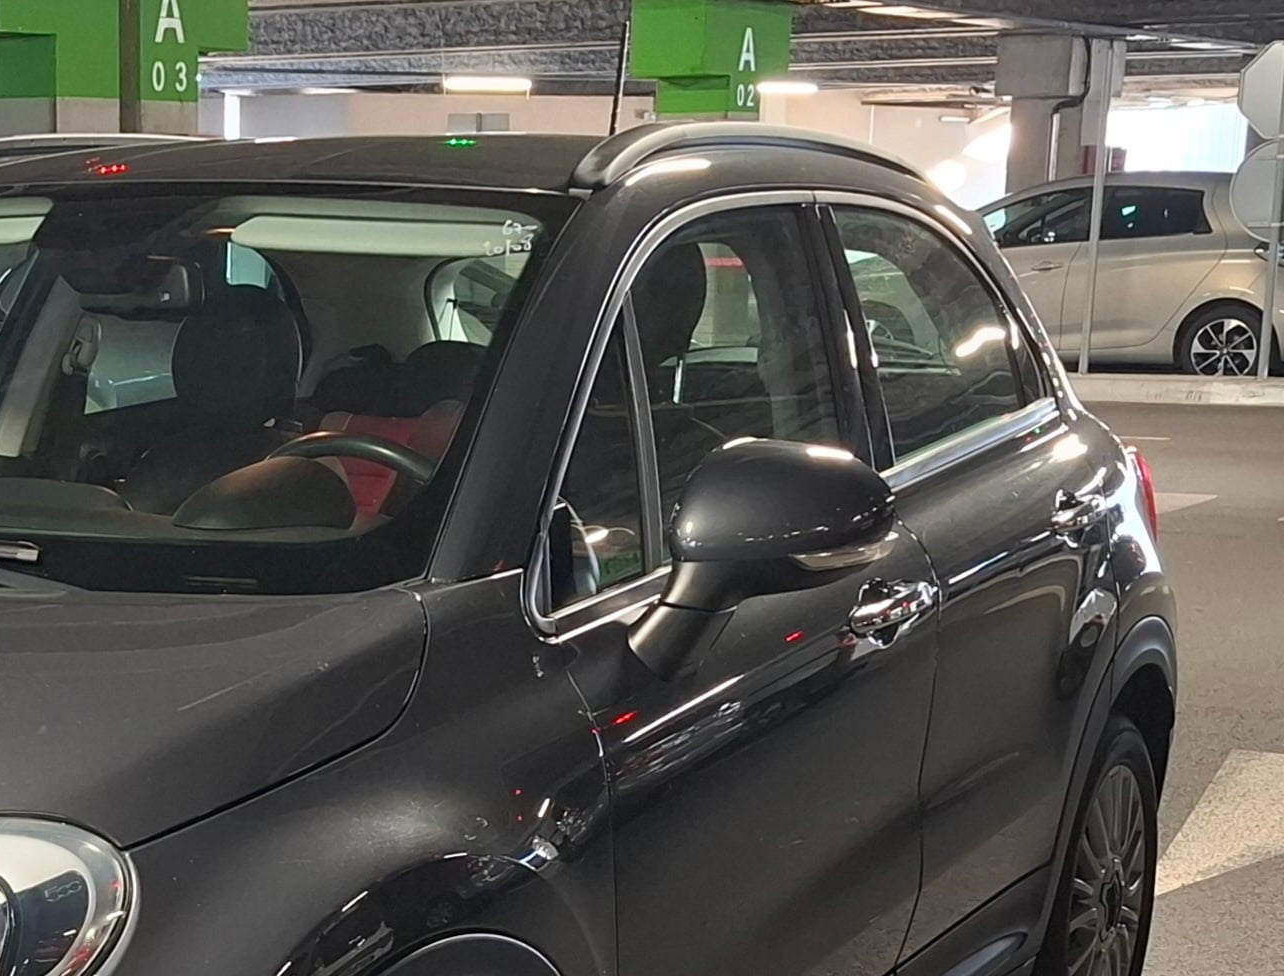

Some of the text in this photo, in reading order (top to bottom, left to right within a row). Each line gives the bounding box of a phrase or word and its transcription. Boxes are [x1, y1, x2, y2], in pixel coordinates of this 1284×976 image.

[154, 0, 186, 43] A
[738, 27, 756, 72] A
[152, 61, 188, 92] 03
[736, 84, 756, 107] 02
